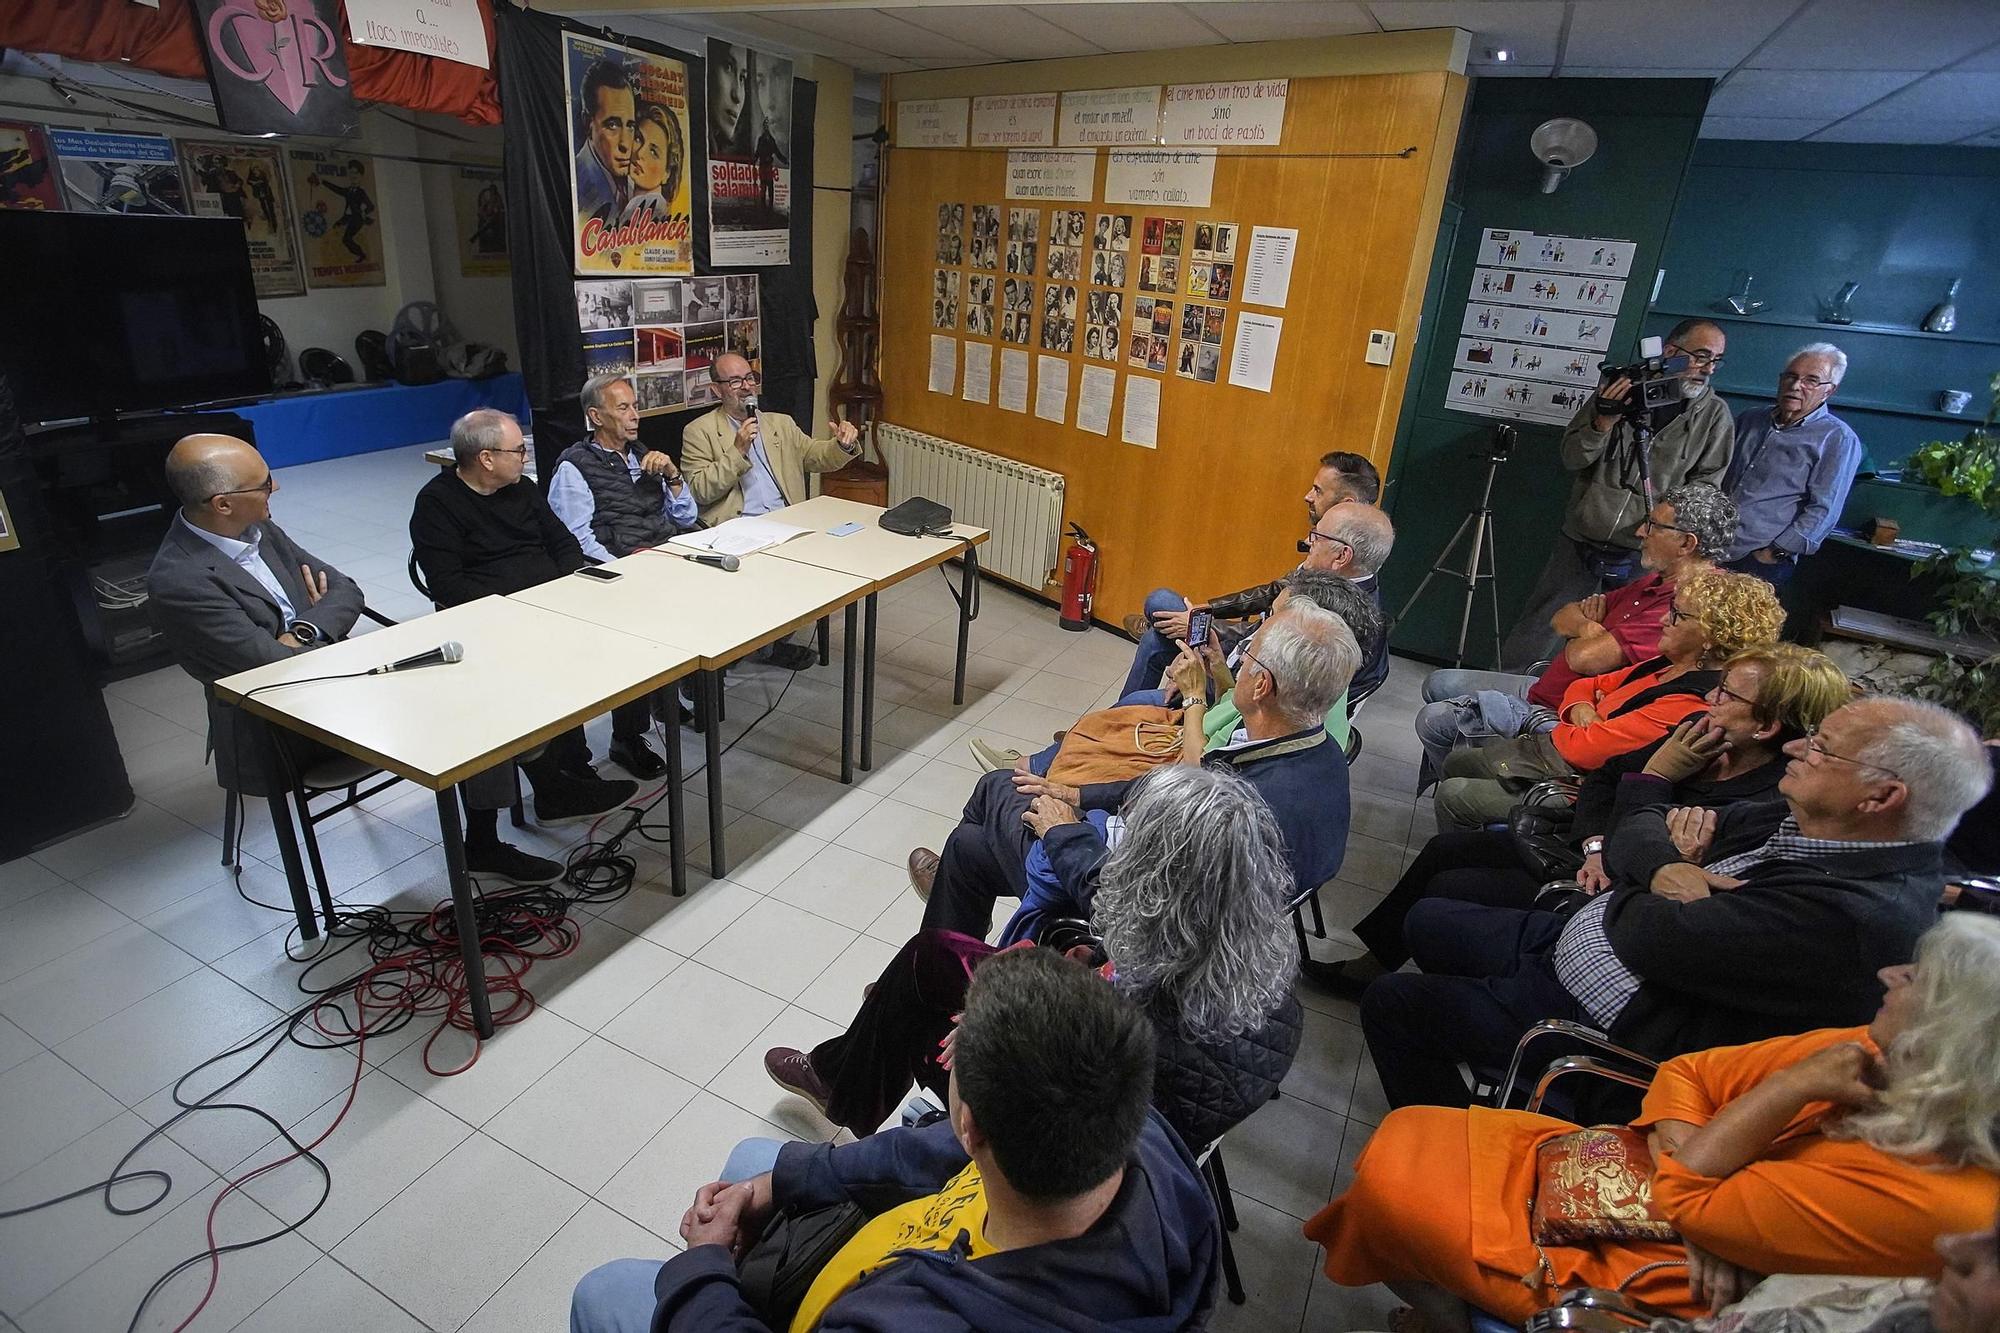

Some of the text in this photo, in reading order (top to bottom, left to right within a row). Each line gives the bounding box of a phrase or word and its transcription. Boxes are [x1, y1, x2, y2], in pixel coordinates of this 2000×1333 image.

[366, 20, 459, 56] llocs impossibles
[1176, 88, 1192, 101] cine
[1218, 86, 1230, 100] un
[1232, 84, 1250, 99] tros
[1253, 82, 1265, 98] de
[1267, 80, 1286, 98] vida
[1211, 104, 1231, 120] sinó
[1183, 127, 1195, 140] un
[1222, 124, 1233, 140] de
[711, 161, 766, 183] soldado
[581, 206, 689, 257] Casablanca
